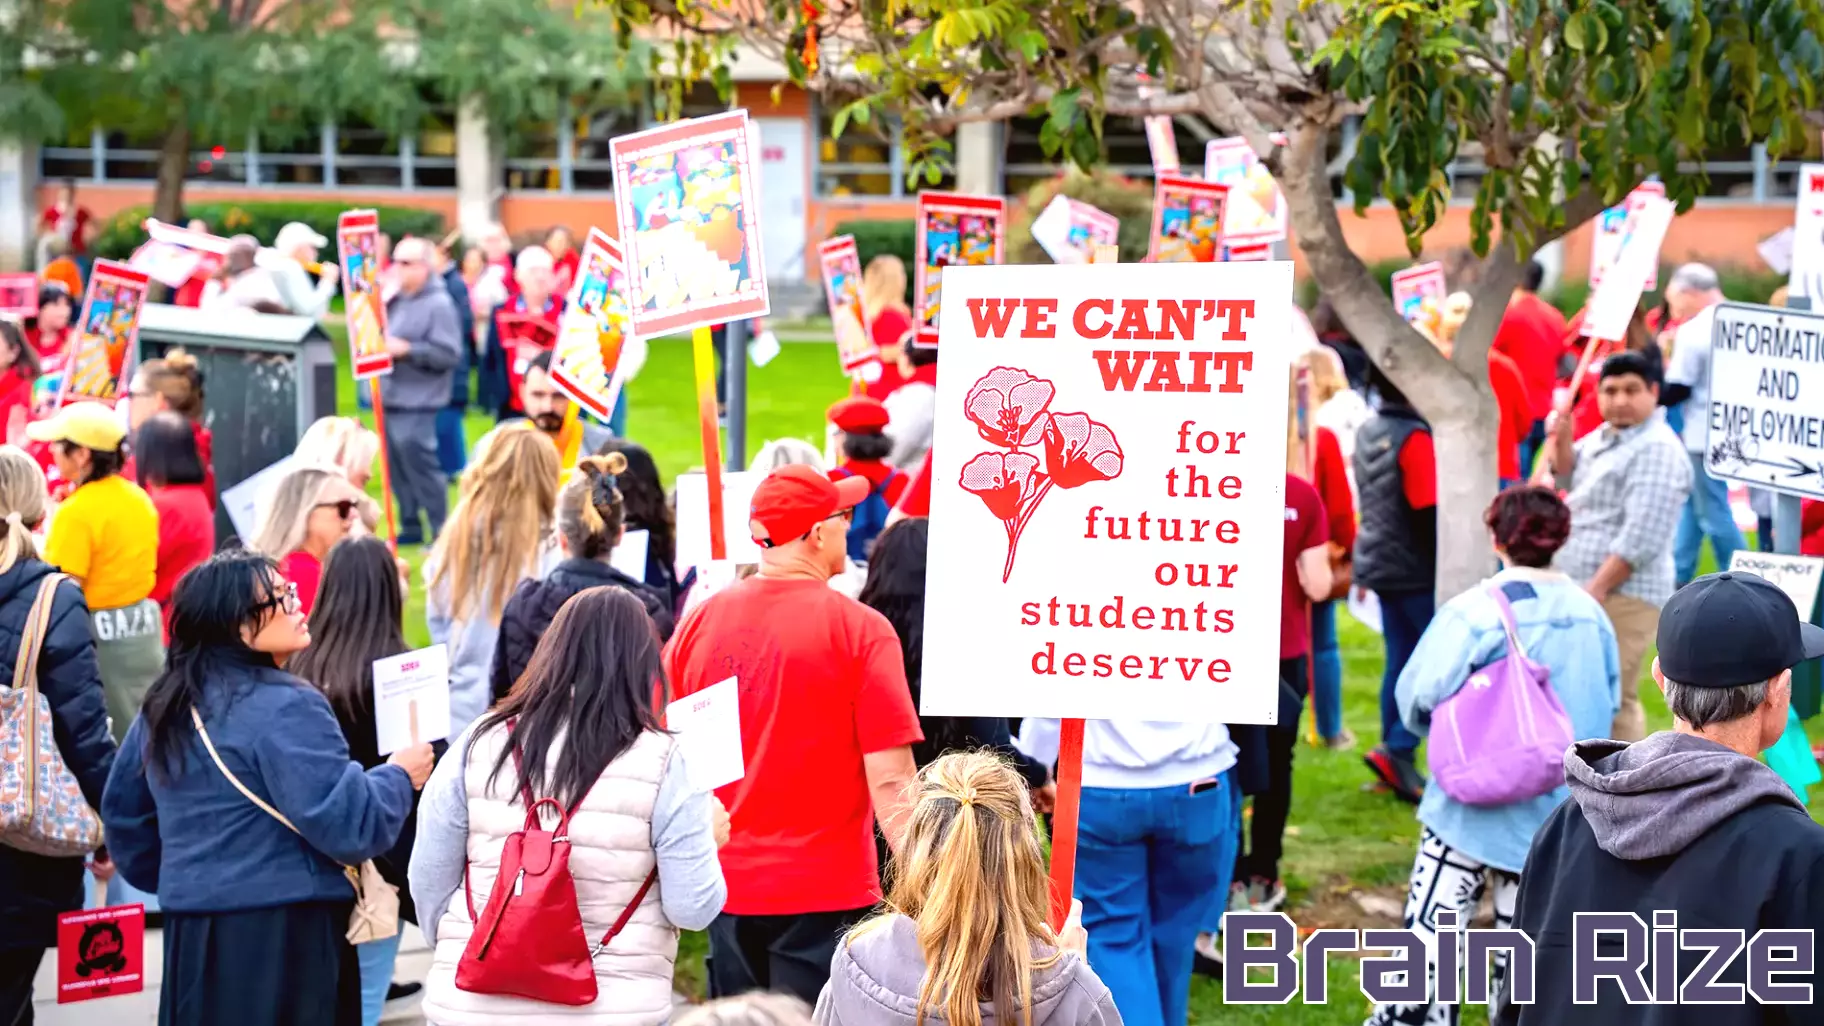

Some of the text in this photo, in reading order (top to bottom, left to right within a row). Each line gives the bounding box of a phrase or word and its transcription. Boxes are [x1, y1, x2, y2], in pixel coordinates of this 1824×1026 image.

[966, 297, 1255, 341] WE CAN'T
[1092, 350, 1253, 393] WAIT
[1757, 366, 1800, 401] AND
[1176, 420, 1246, 454] for
[1710, 401, 1824, 449] EMPLOYME
[1166, 465, 1242, 499] the
[1084, 506, 1240, 544] future
[1155, 562, 1239, 588] our
[1021, 596, 1234, 633] students
[1032, 642, 1231, 683] deserve
